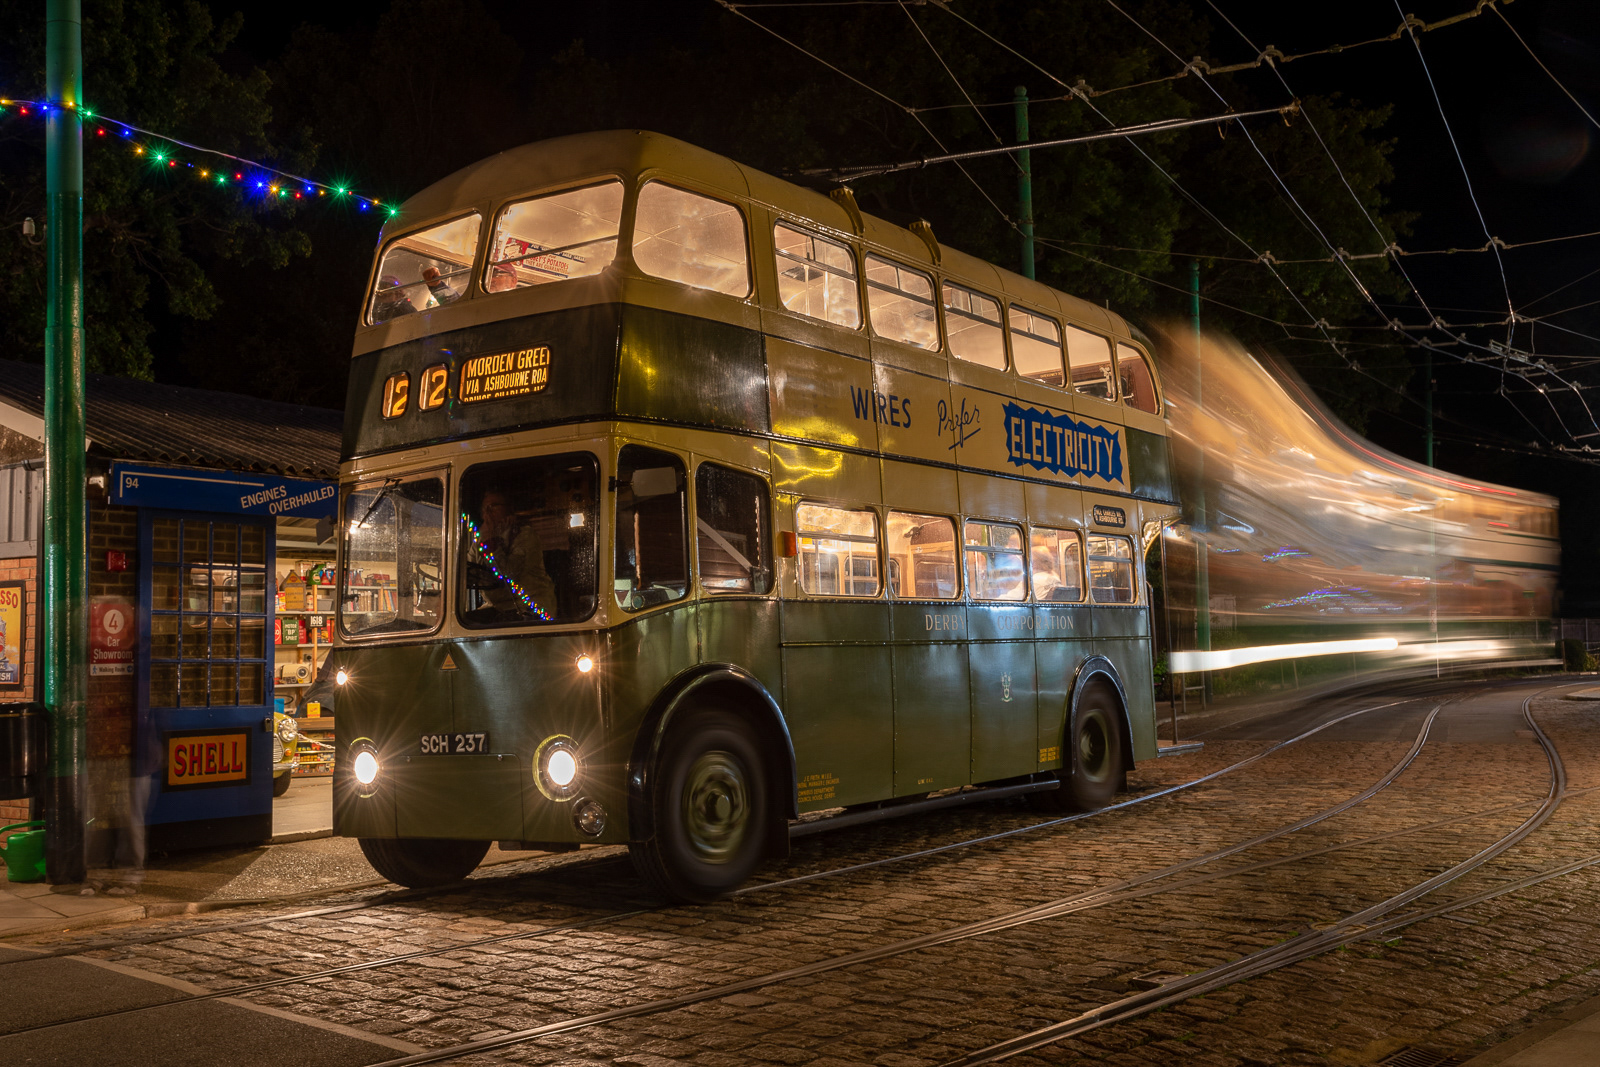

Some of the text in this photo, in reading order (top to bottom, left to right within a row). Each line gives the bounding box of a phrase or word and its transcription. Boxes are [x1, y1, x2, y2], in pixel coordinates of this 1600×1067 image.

[467, 347, 550, 378] MORDEN GREE
[466, 379, 480, 395] VIA
[484, 370, 529, 392] ASHBOURNE
[849, 385, 1114, 477] WIRES Prefer ELECTRICITY
[125, 477, 139, 489] 94
[240, 485, 287, 509] ENGINES
[268, 485, 335, 515] OVERHAULED
[108, 613, 119, 631] 4
[310, 615, 323, 625] 1618
[924, 614, 1074, 631] DERBY CORPORATION
[107, 636, 121, 647] Car
[93, 648, 133, 660] Showroom
[98, 665, 114, 674] Walking
[420, 733, 485, 754] SCH 237
[174, 741, 243, 777] SHELL
